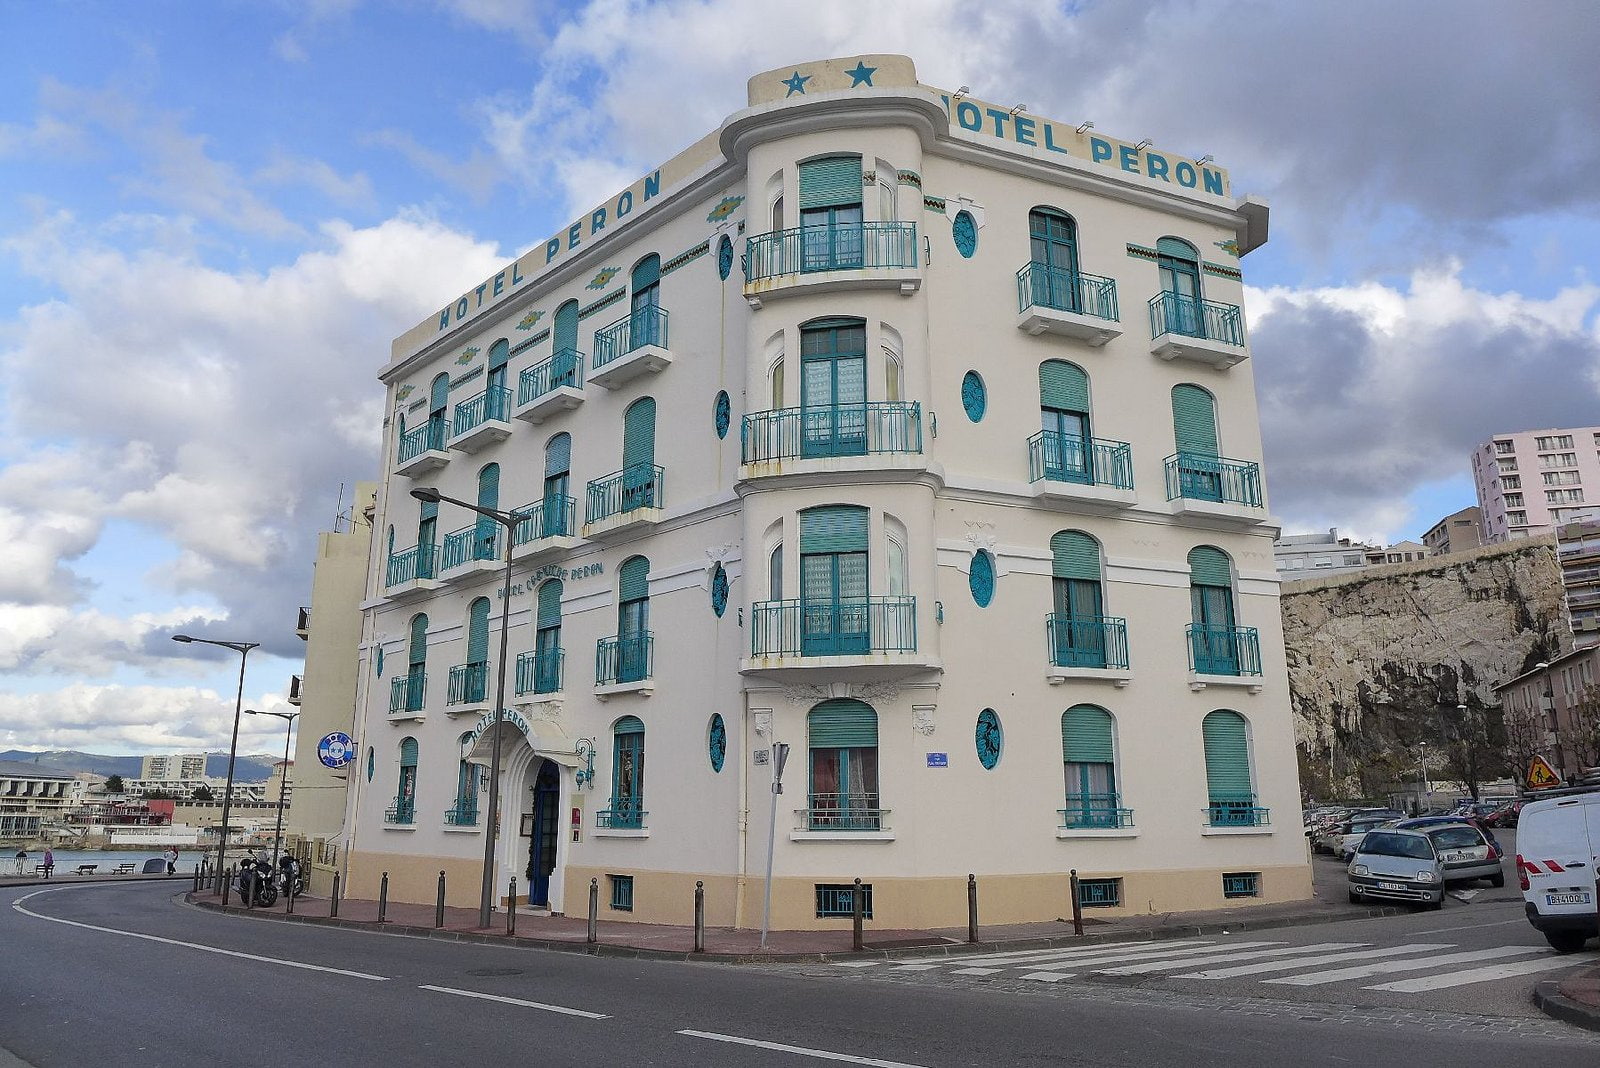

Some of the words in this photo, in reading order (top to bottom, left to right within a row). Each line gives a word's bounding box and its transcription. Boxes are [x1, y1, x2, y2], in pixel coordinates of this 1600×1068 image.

[941, 95, 1068, 155] OTEL
[1090, 136, 1224, 196] PERON
[439, 262, 524, 332] HOTEL
[545, 170, 661, 265] PERON
[470, 710, 497, 744] HOTEL
[502, 708, 530, 736] PERON
